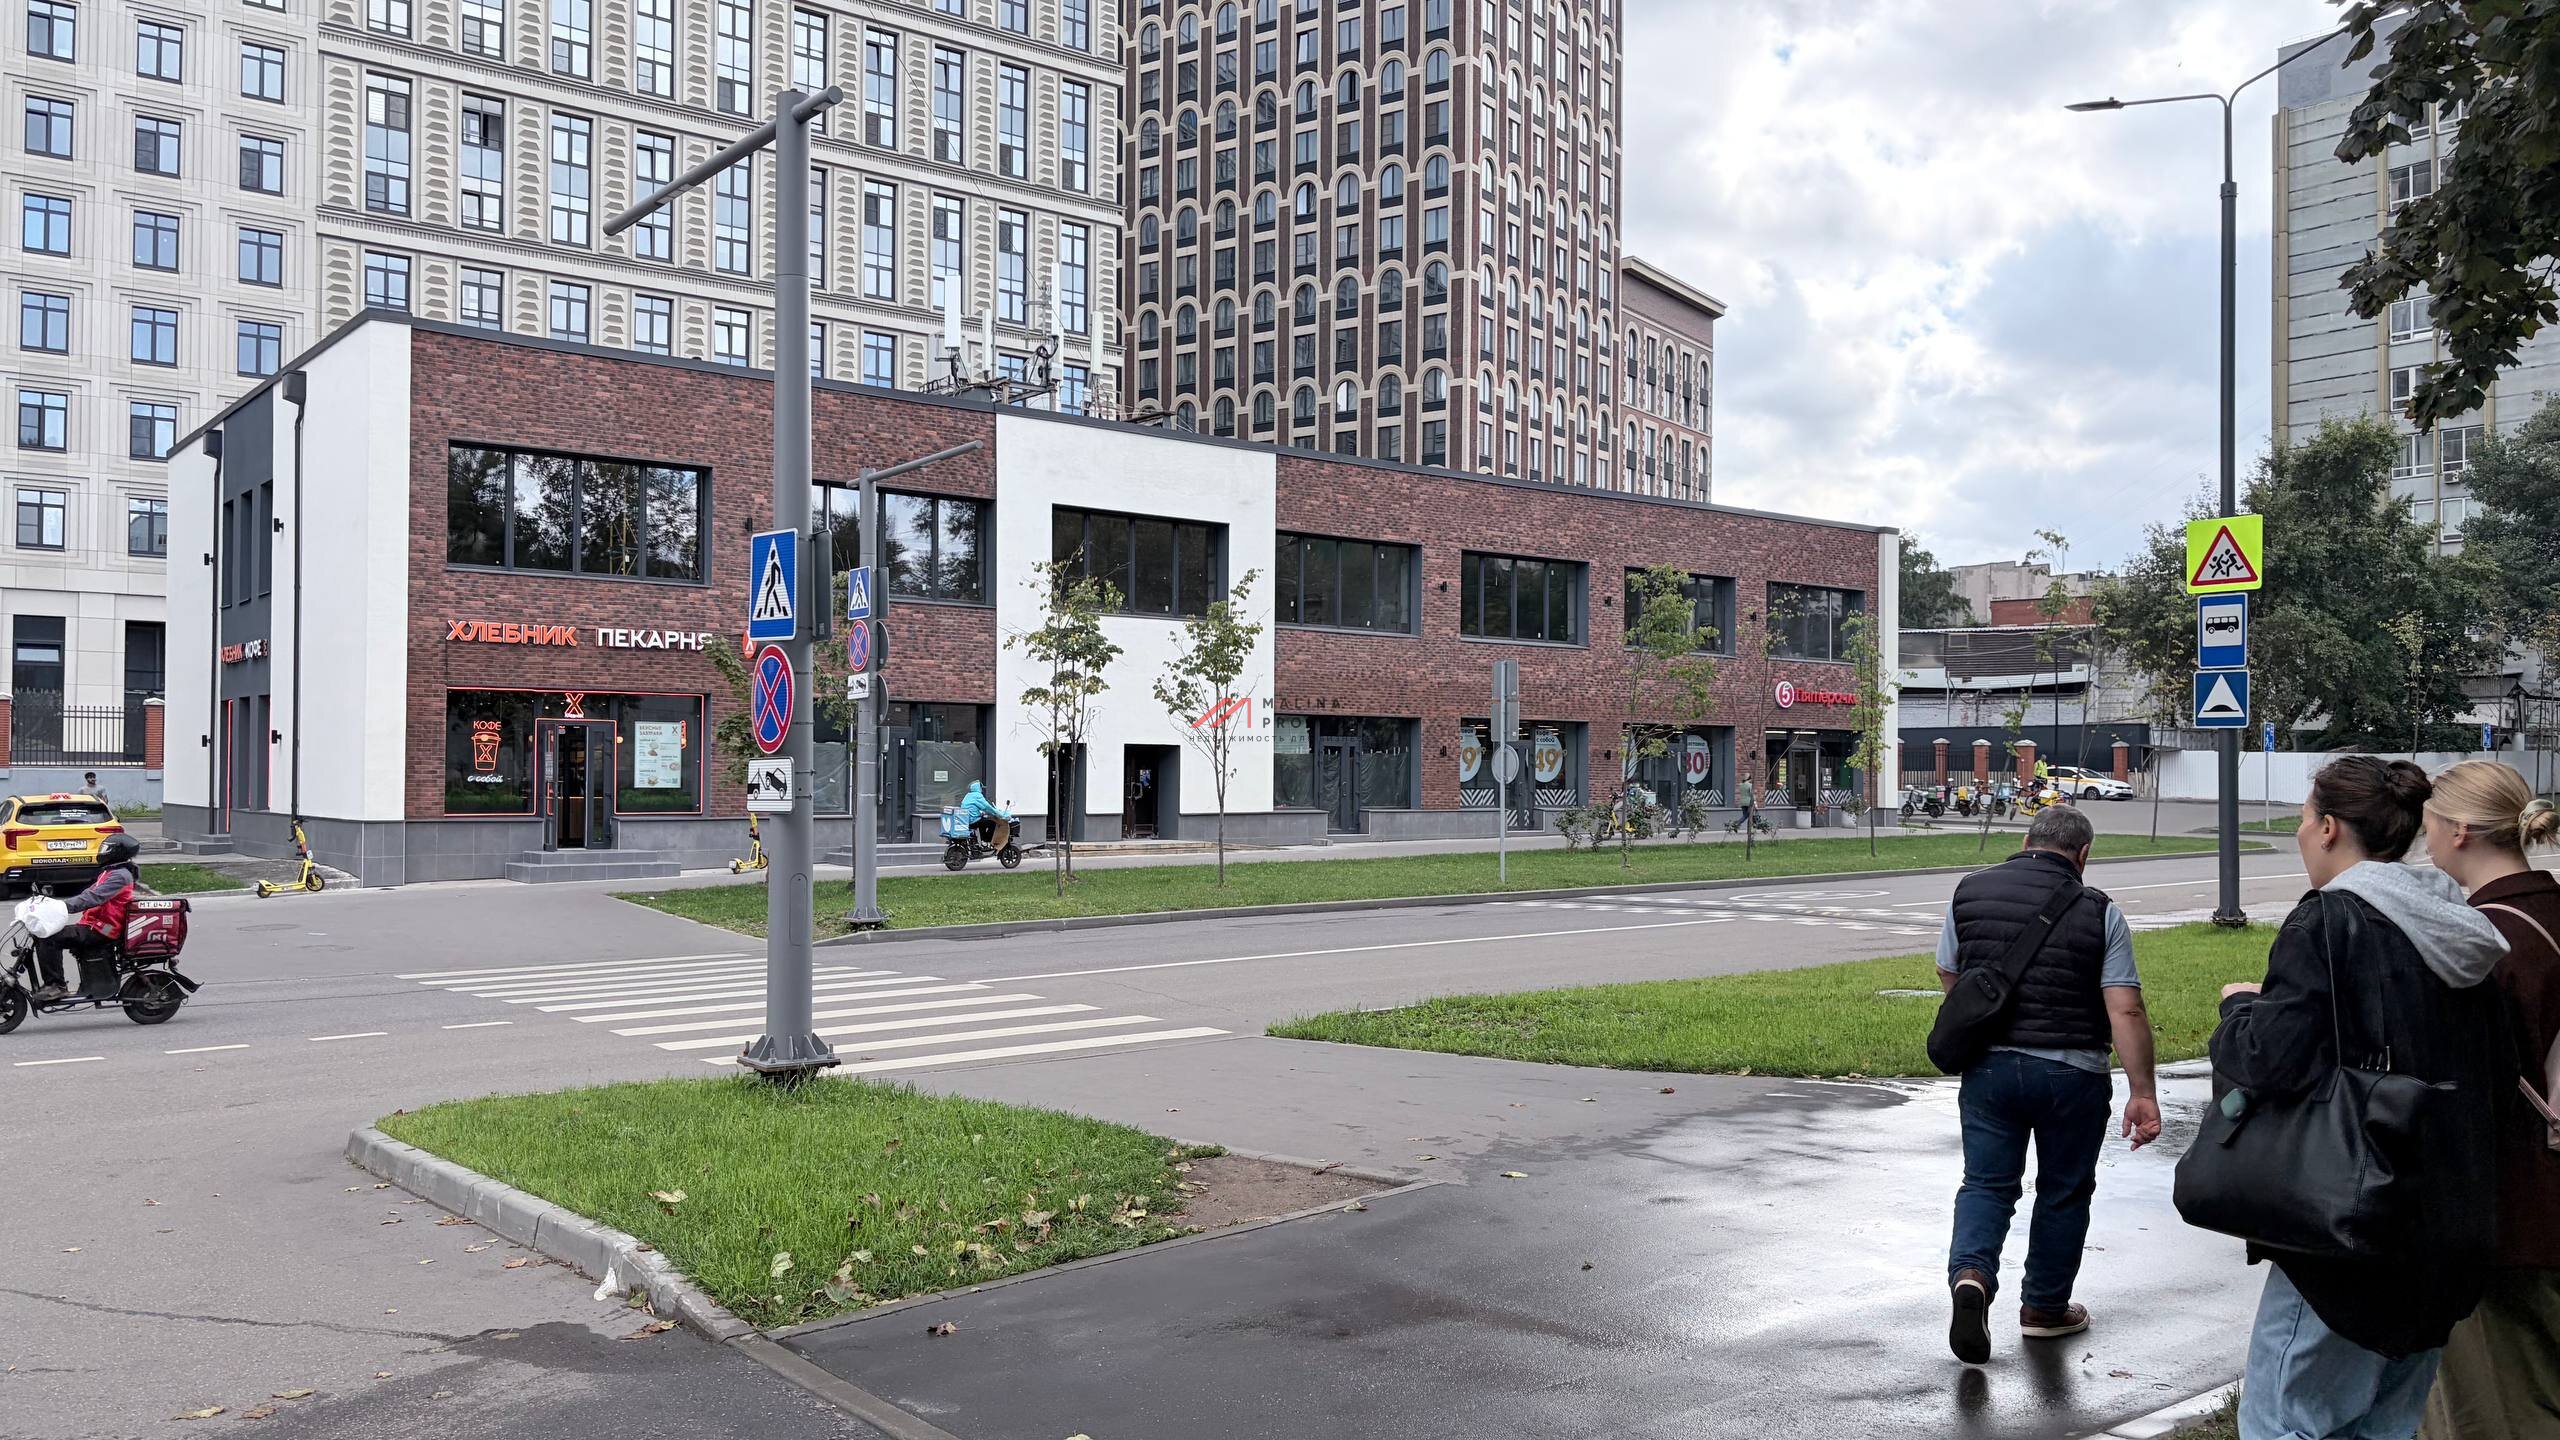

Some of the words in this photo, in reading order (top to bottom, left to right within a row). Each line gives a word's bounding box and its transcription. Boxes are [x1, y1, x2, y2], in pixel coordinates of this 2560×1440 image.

[446, 619, 578, 647] ХЛЕБНИК
[1795, 687, 1861, 711] Пятёрочк
[473, 720, 502, 731] КОФЕ
[32, 857, 67, 865] ШОКОЛАД
